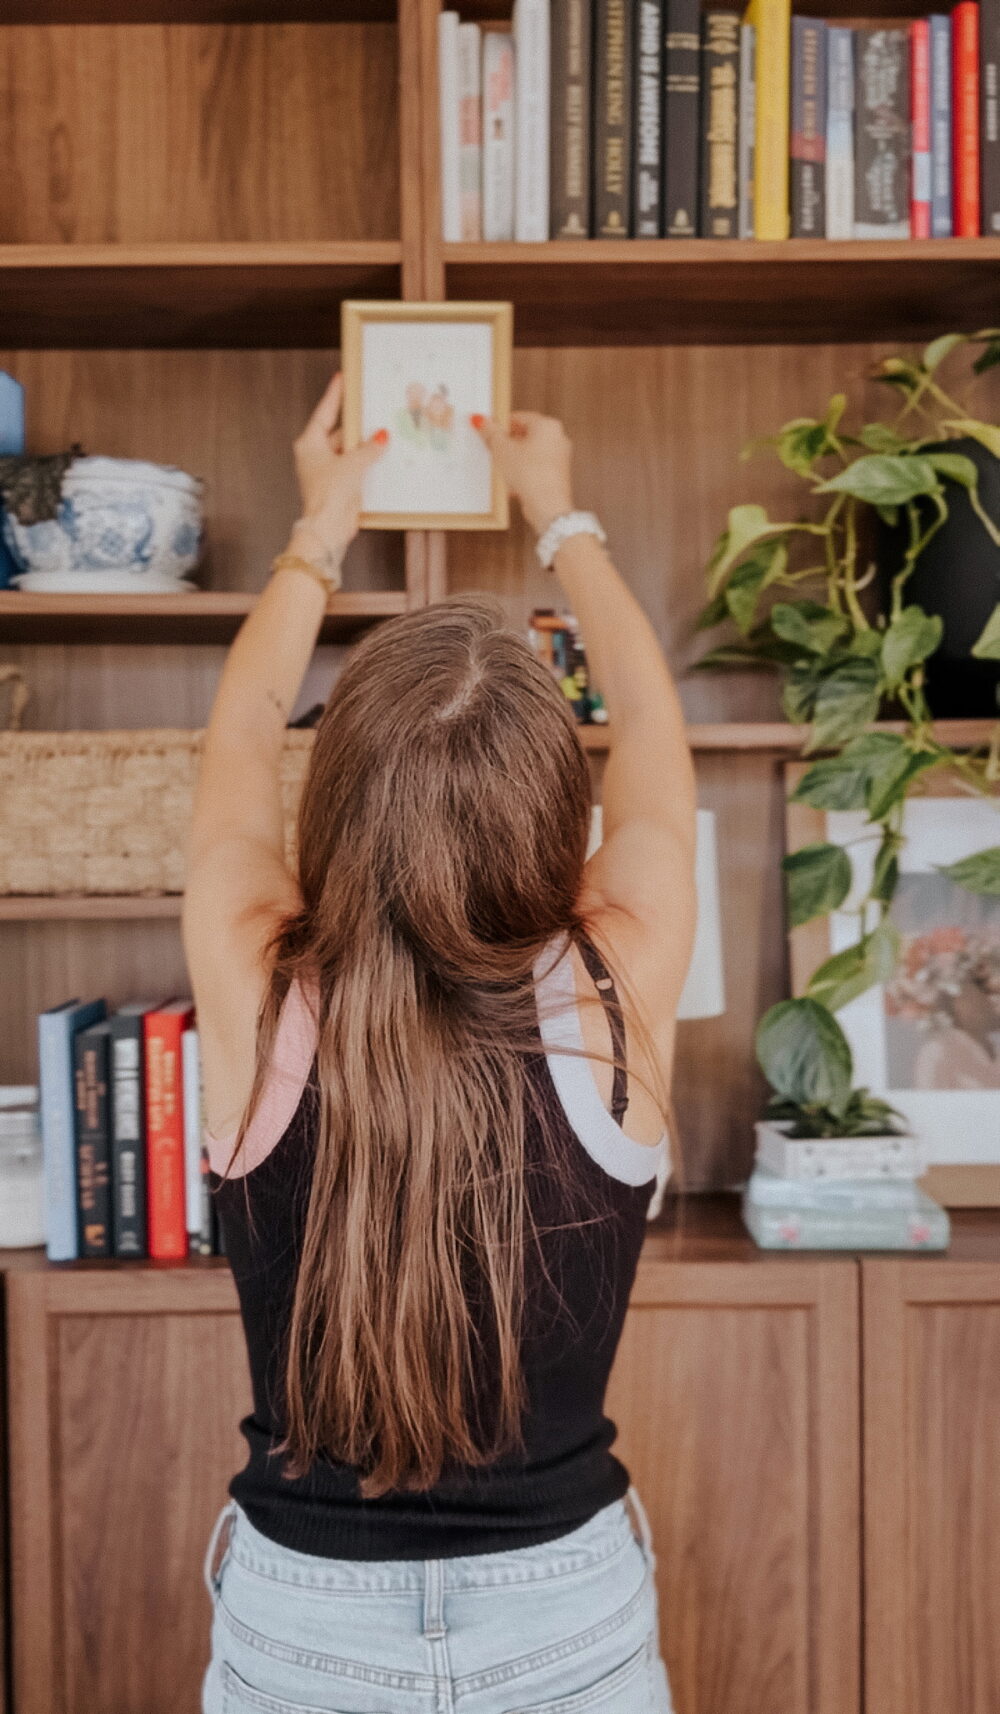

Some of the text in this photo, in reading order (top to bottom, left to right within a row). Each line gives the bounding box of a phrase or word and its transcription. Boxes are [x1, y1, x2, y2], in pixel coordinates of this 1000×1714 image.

[639, 1, 660, 54] ADHD
[639, 56, 660, 73] IS
[638, 75, 660, 165] AWESOME
[605, 137, 624, 195] HOLLY
